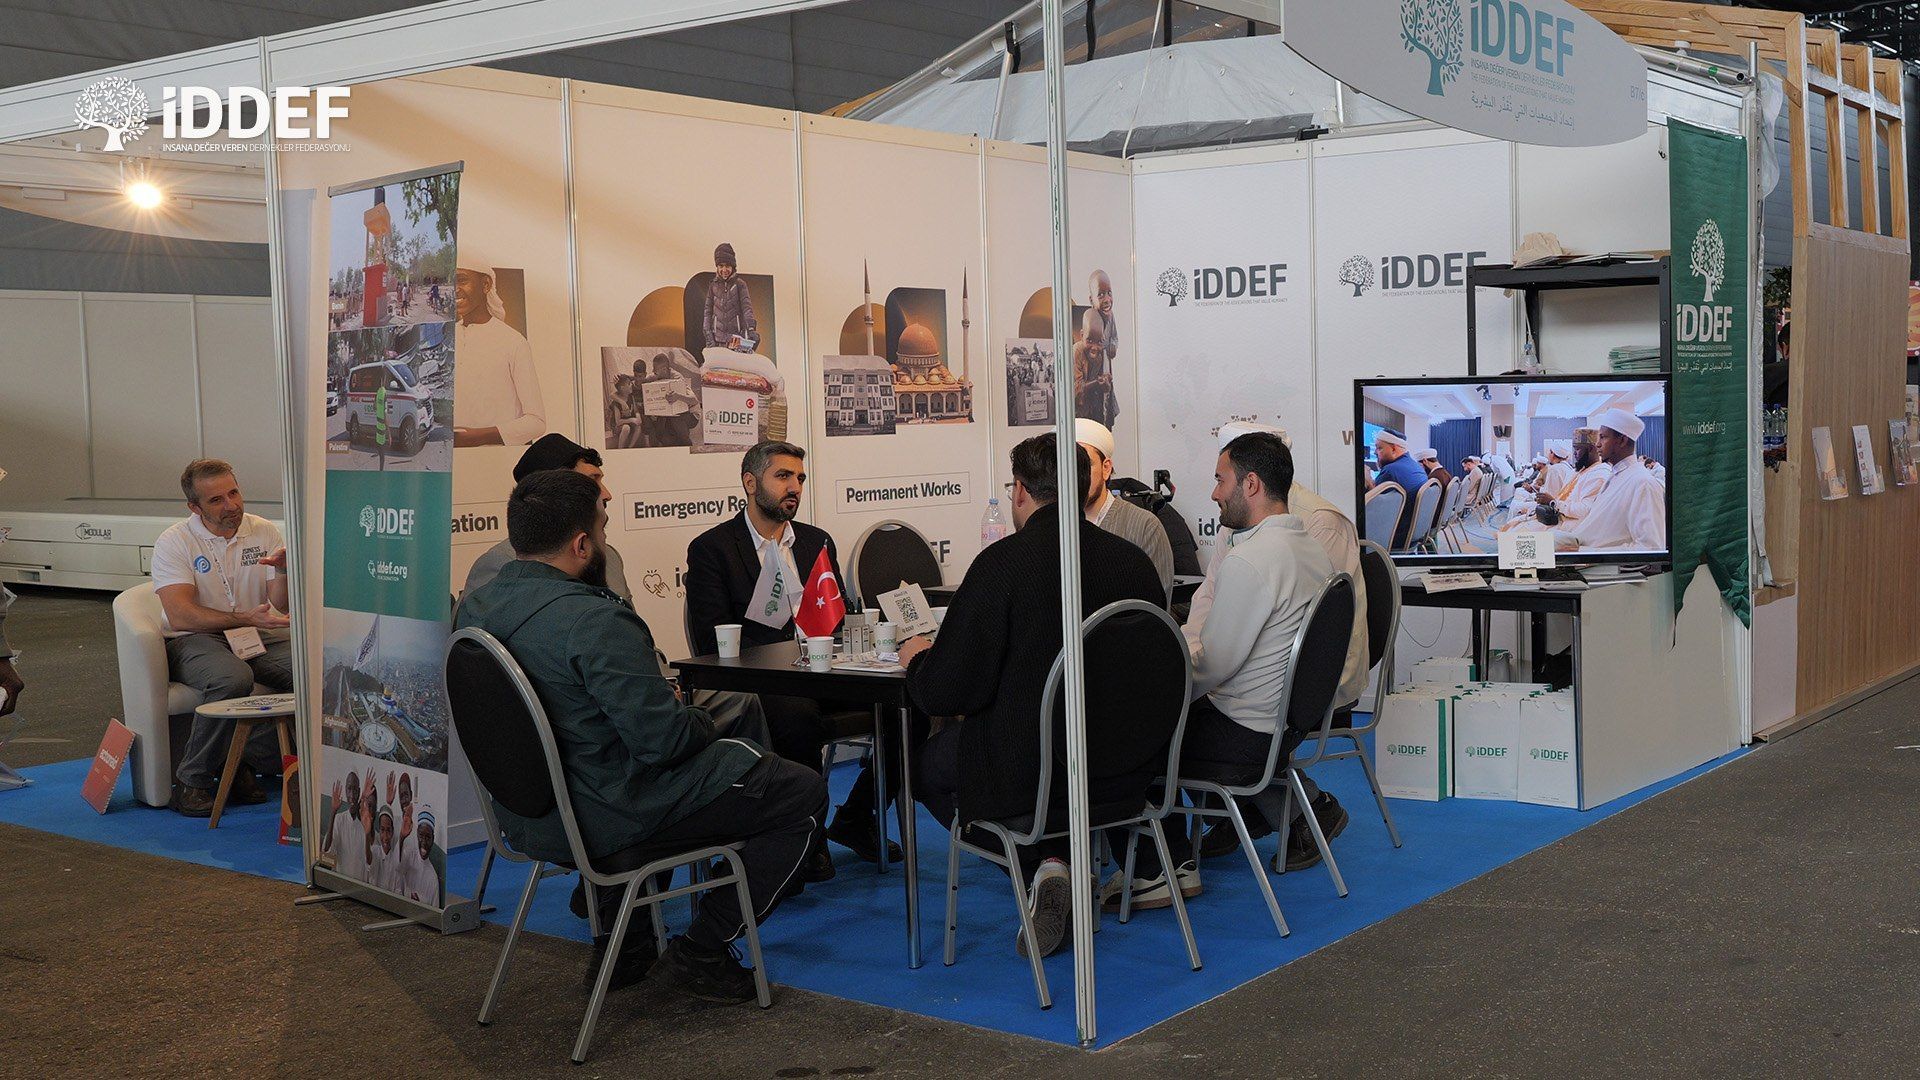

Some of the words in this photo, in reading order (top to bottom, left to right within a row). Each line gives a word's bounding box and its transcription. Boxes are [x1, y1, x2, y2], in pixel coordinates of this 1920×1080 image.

[1471, 0, 1575, 77] iDDEF
[1194, 264, 1287, 299] iDDEF
[1677, 304, 1733, 342] iDDEF
[719, 410, 754, 425] iDDEF
[846, 483, 918, 503] Permanent
[920, 481, 961, 498] Works
[634, 500, 724, 519] Emergency
[728, 495, 747, 512] Re
[377, 507, 415, 535] iDDEF
[451, 513, 498, 534] ation
[377, 560, 408, 579] iddef.org
[1398, 743, 1428, 756] iDDEF
[1476, 746, 1508, 757] iDDEF
[1540, 748, 1569, 761] iDDEF
